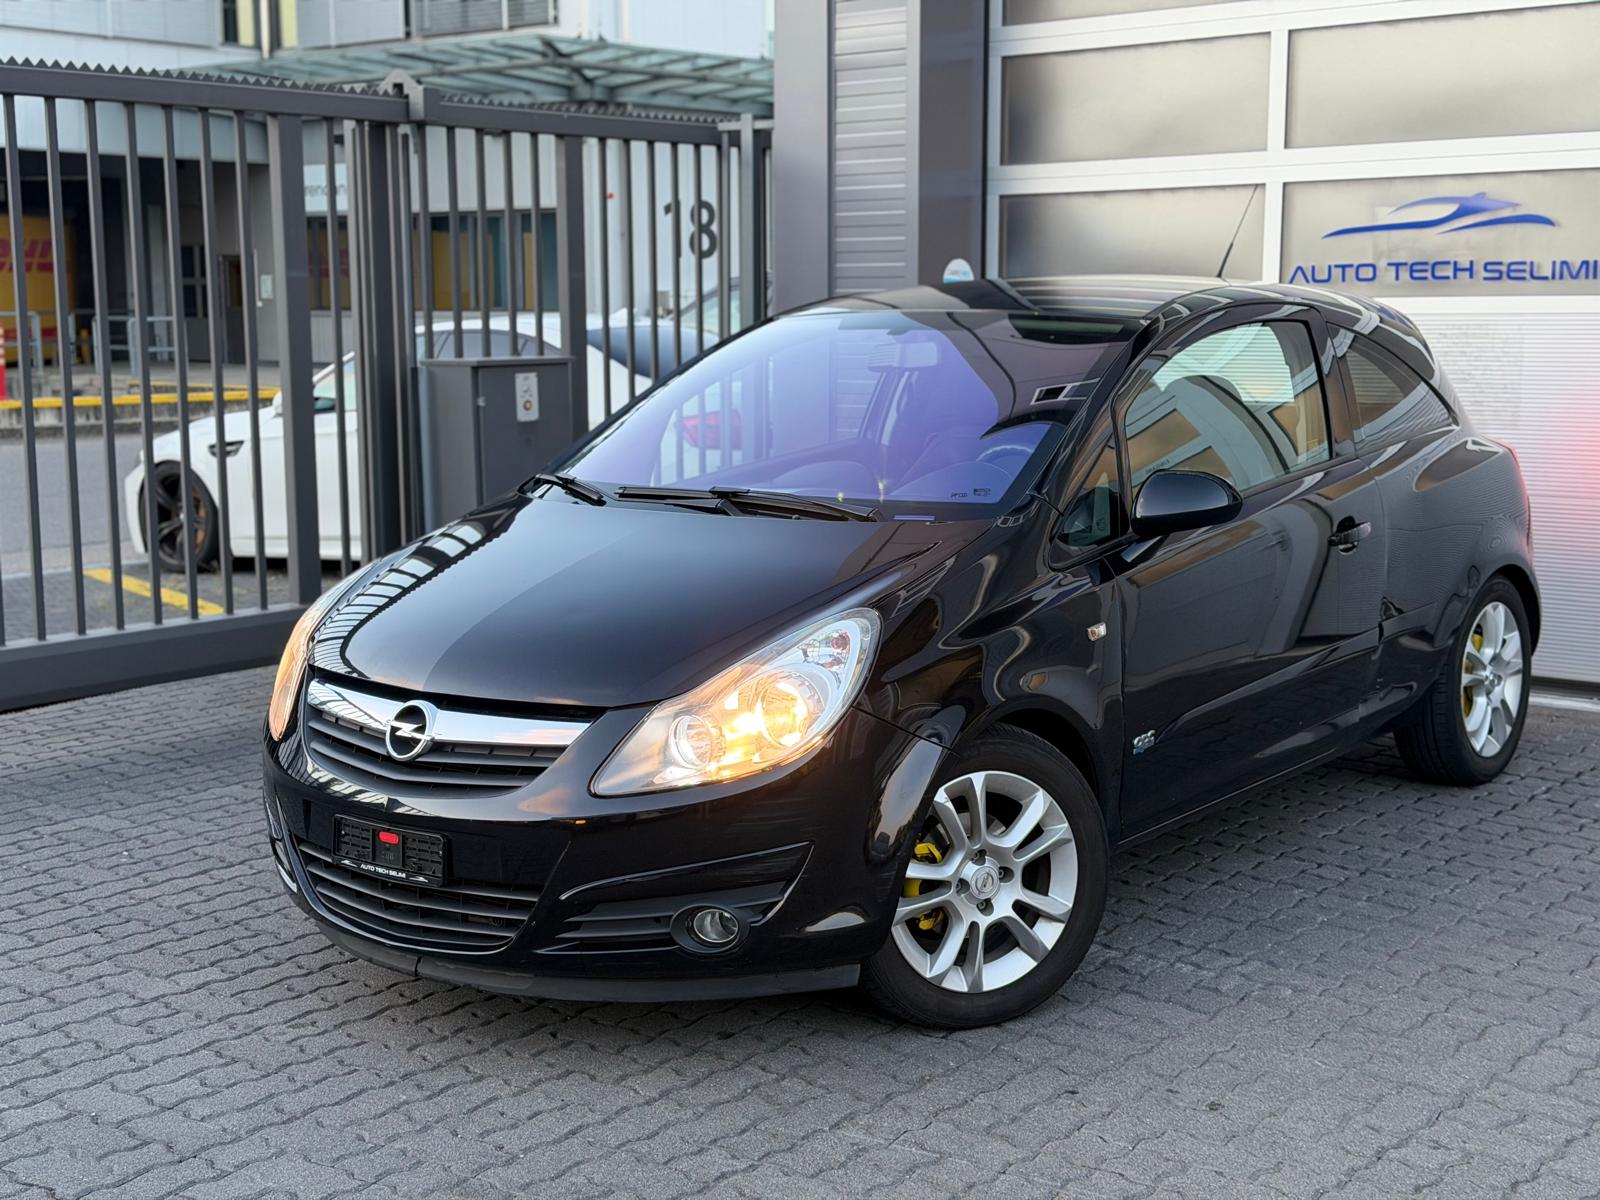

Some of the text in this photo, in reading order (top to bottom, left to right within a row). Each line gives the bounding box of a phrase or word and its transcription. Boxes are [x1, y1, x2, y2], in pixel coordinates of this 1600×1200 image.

[663, 199, 718, 260] 18
[1288, 259, 1599, 284] AUTO TECH SELIMI
[360, 863, 375, 872] AUTO
[375, 866, 389, 875] TECH
